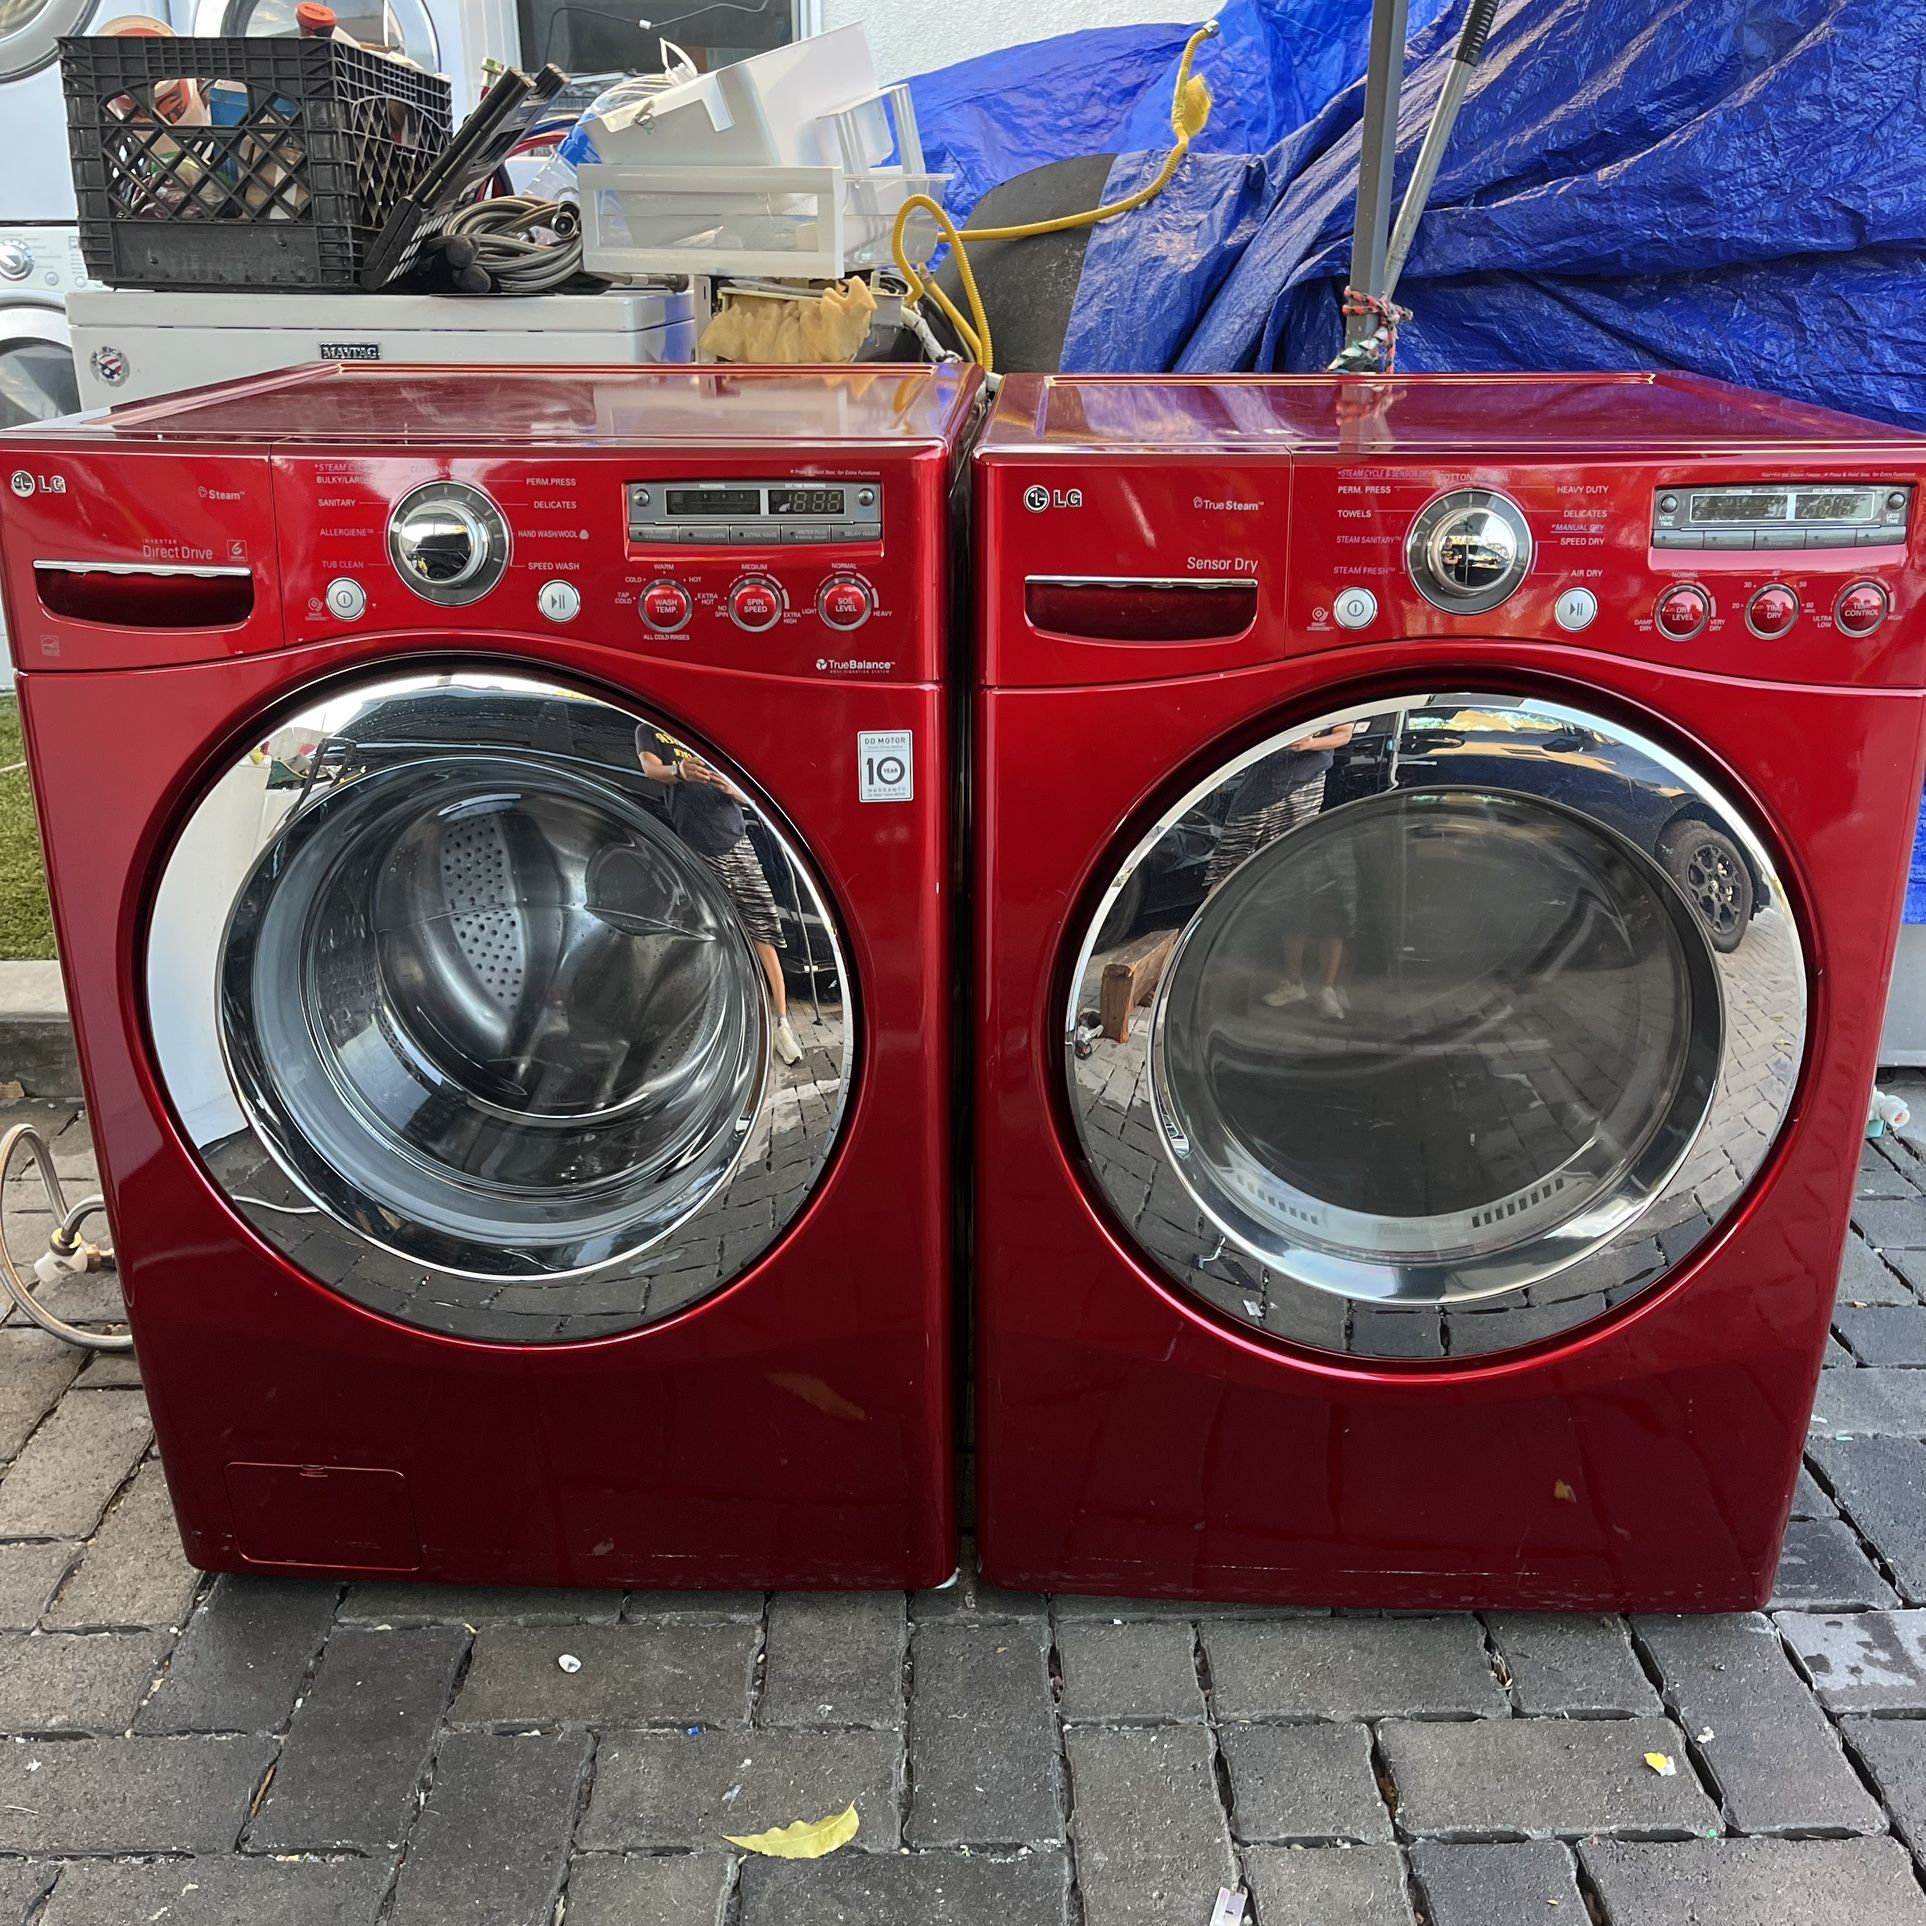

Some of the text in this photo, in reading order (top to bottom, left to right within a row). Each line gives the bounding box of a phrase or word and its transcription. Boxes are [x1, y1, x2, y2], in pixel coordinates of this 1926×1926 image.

[322, 346, 377, 359] MAYTAG
[1365, 469, 1384, 477] CYCLE
[1392, 470, 1417, 478] SENSOR
[38, 475, 67, 494] LG
[551, 478, 576, 486] PRESS
[1365, 486, 1391, 494] PRESS
[1557, 486, 1609, 494] HEAVY DUTY
[1053, 488, 1082, 508] LG
[318, 499, 355, 507] SANITARY
[533, 500, 577, 509] DELICATES
[1338, 510, 1372, 518] TOWELS
[1563, 510, 1608, 518] DELICATES
[1589, 524, 1604, 532] DRY
[518, 530, 578, 538] HAND WASH/WOOL
[1336, 535, 1360, 544] STEAM
[1560, 538, 1605, 546] SPEED DRY
[143, 545, 213, 560] Direct Drive
[322, 560, 364, 569] TUB CLEAN
[528, 562, 580, 570] SPEED WASH
[1187, 556, 1259, 574] Sensor Dry
[1333, 566, 1361, 574] STEAM
[1571, 569, 1603, 577] AIR DRY
[1844, 609, 1879, 617] CONTROL
[866, 756, 905, 786] 10
